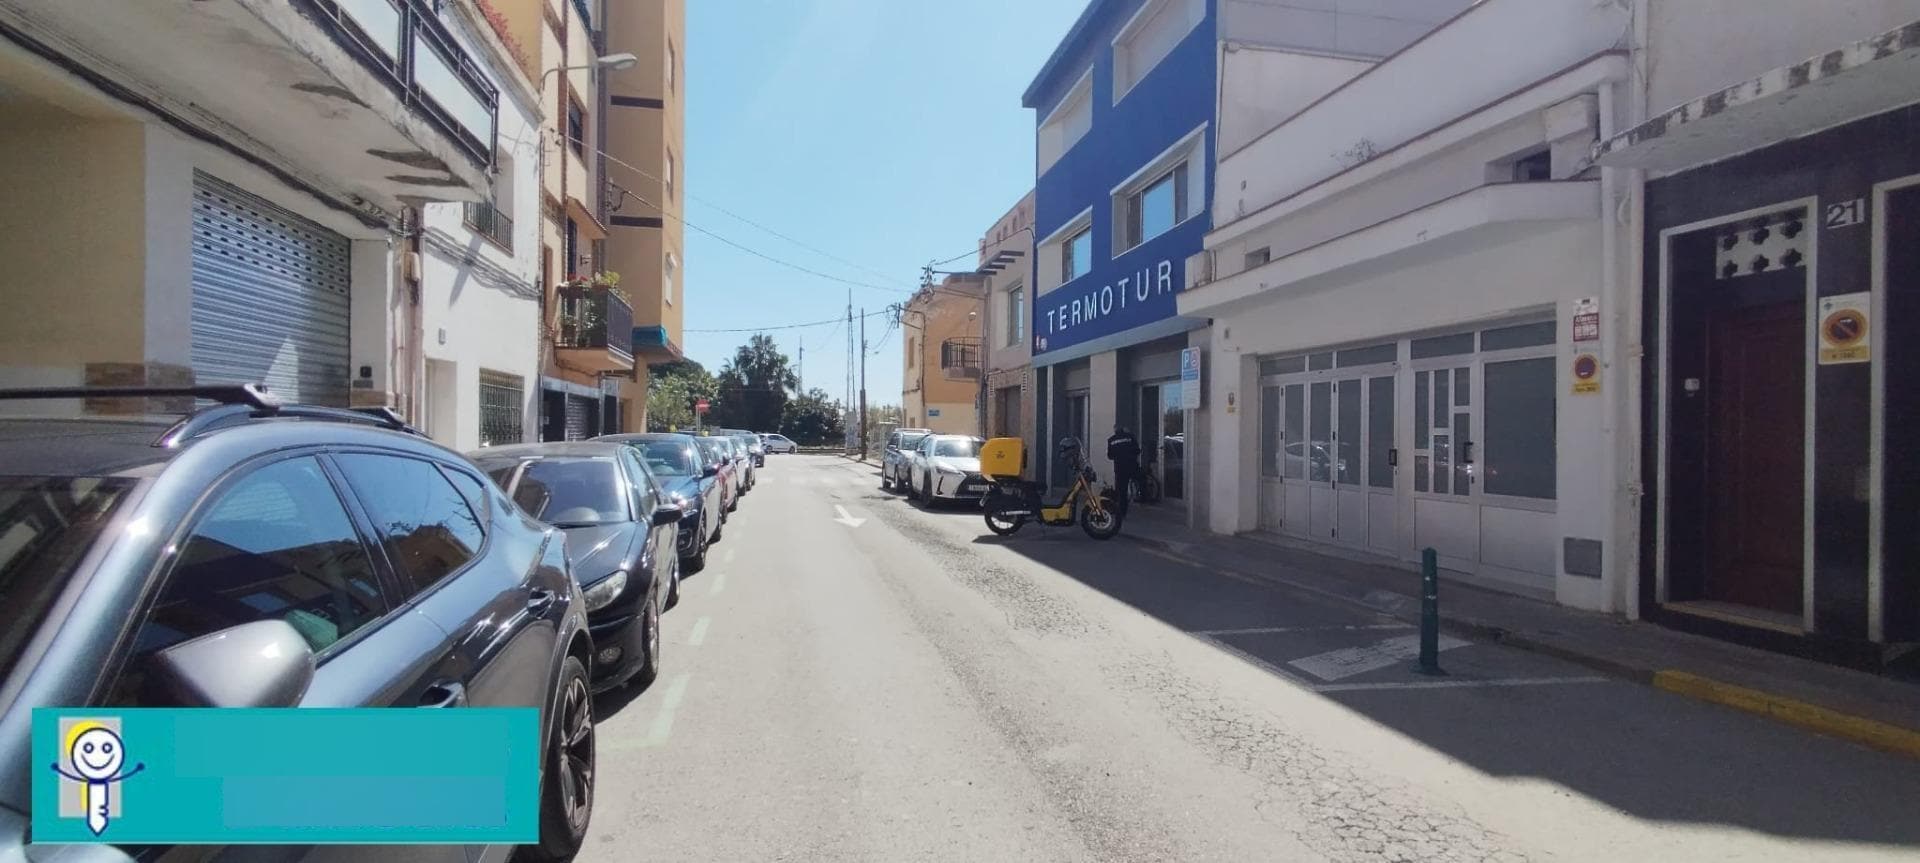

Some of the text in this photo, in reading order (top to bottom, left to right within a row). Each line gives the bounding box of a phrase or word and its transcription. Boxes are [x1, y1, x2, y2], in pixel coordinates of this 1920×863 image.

[1827, 200, 1858, 227] 21
[1047, 259, 1172, 335] TERMOTUR
[1184, 353, 1190, 369] P
